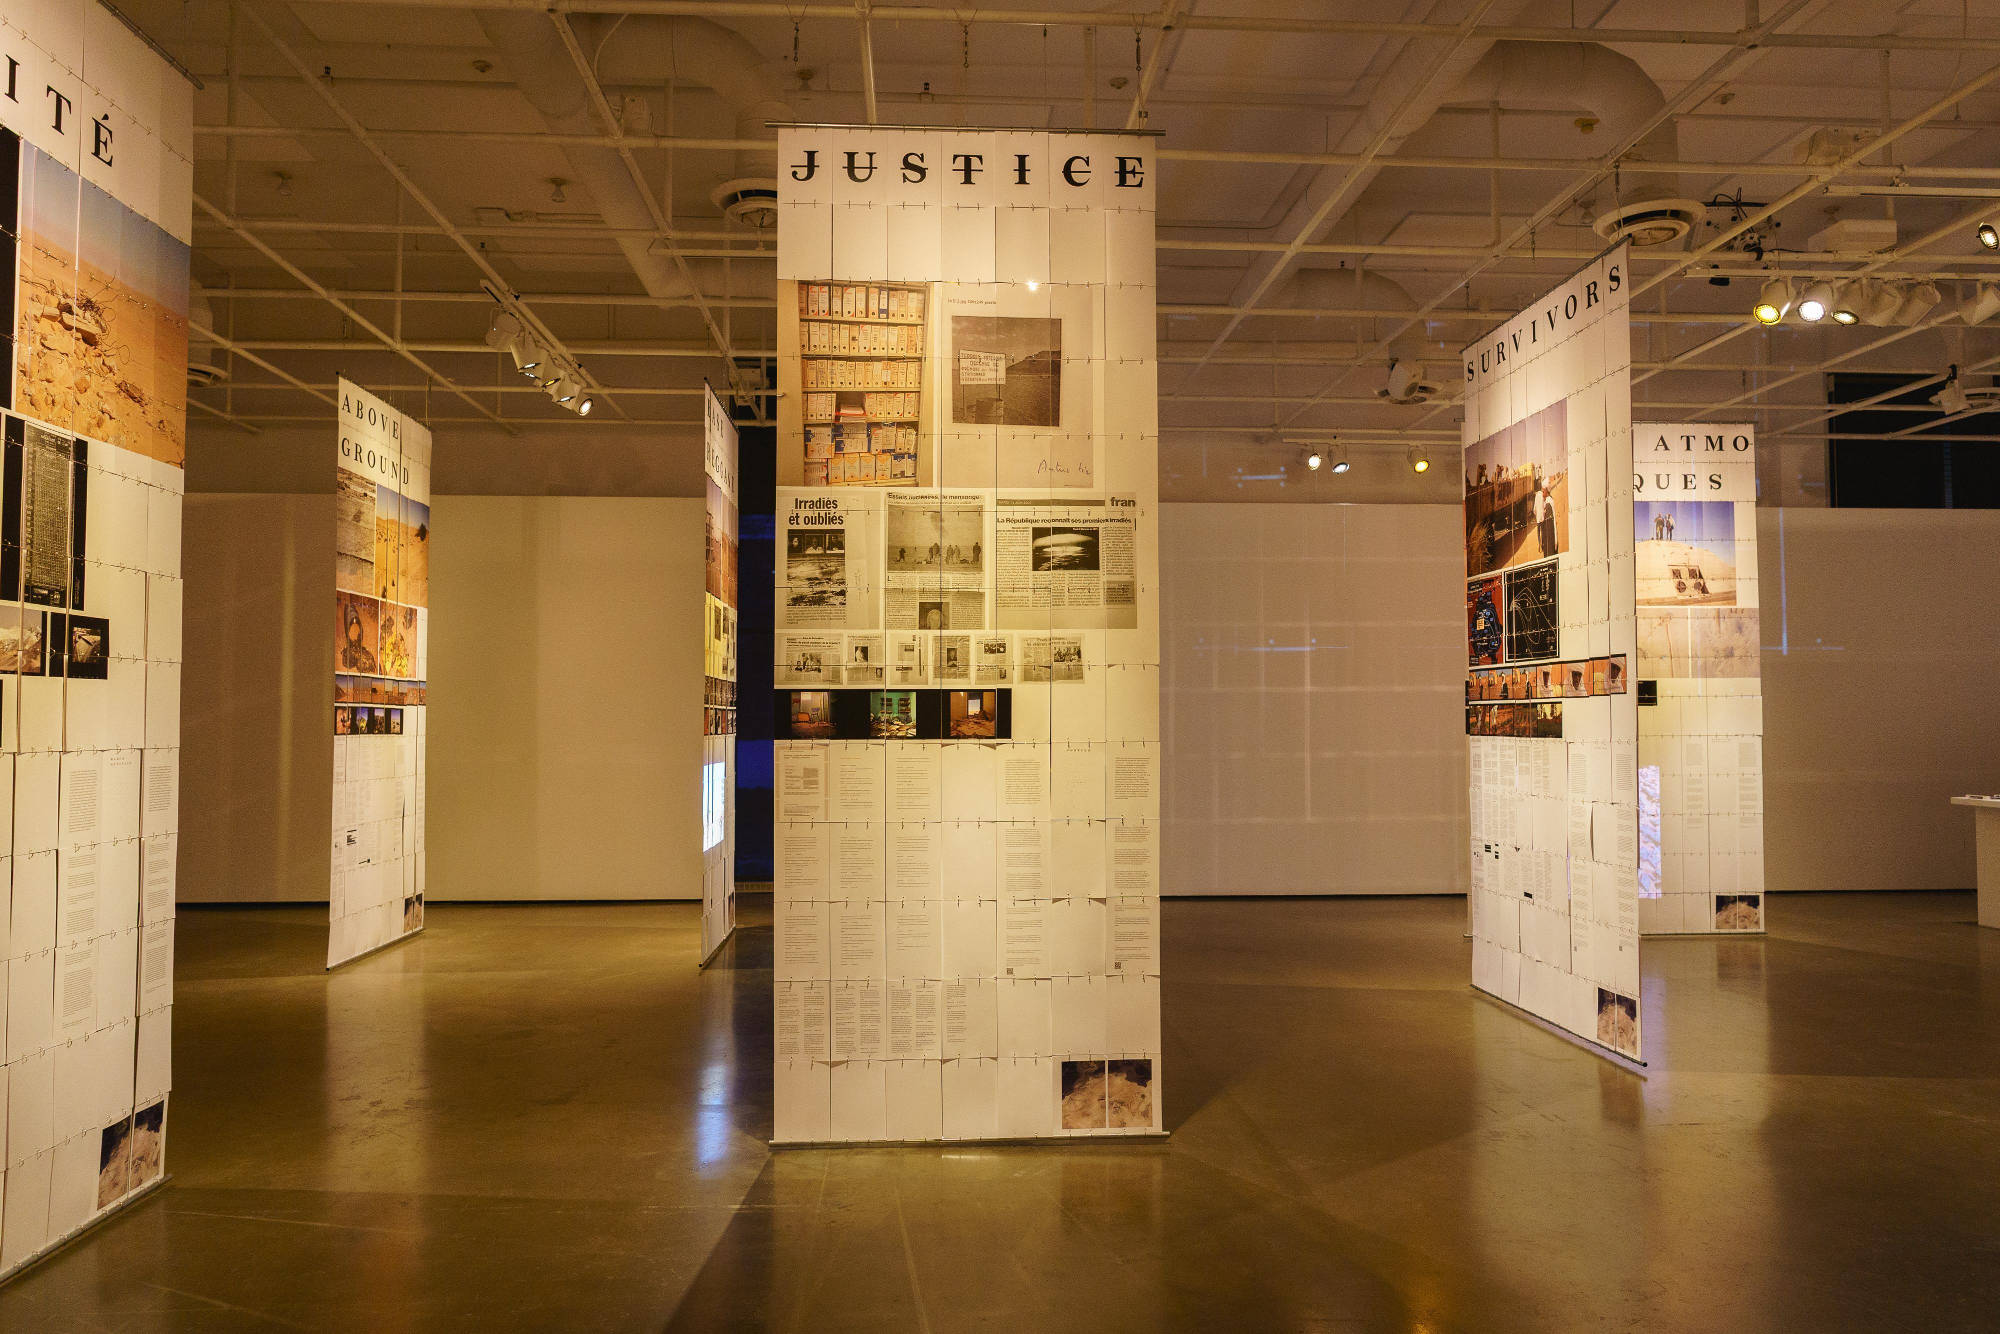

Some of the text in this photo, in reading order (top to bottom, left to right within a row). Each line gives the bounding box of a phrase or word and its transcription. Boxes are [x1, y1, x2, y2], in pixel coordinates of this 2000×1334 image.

[4, 53, 113, 168] ITÉ
[790, 150, 1145, 188] JUSTICE
[1467, 264, 1622, 383] SURVIVORS
[342, 393, 399, 440] ABOVE
[341, 437, 409, 485] GROUND
[789, 511, 844, 525] et oubliés
[795, 497, 838, 509] Irradiés
[1110, 497, 1136, 507] fran
